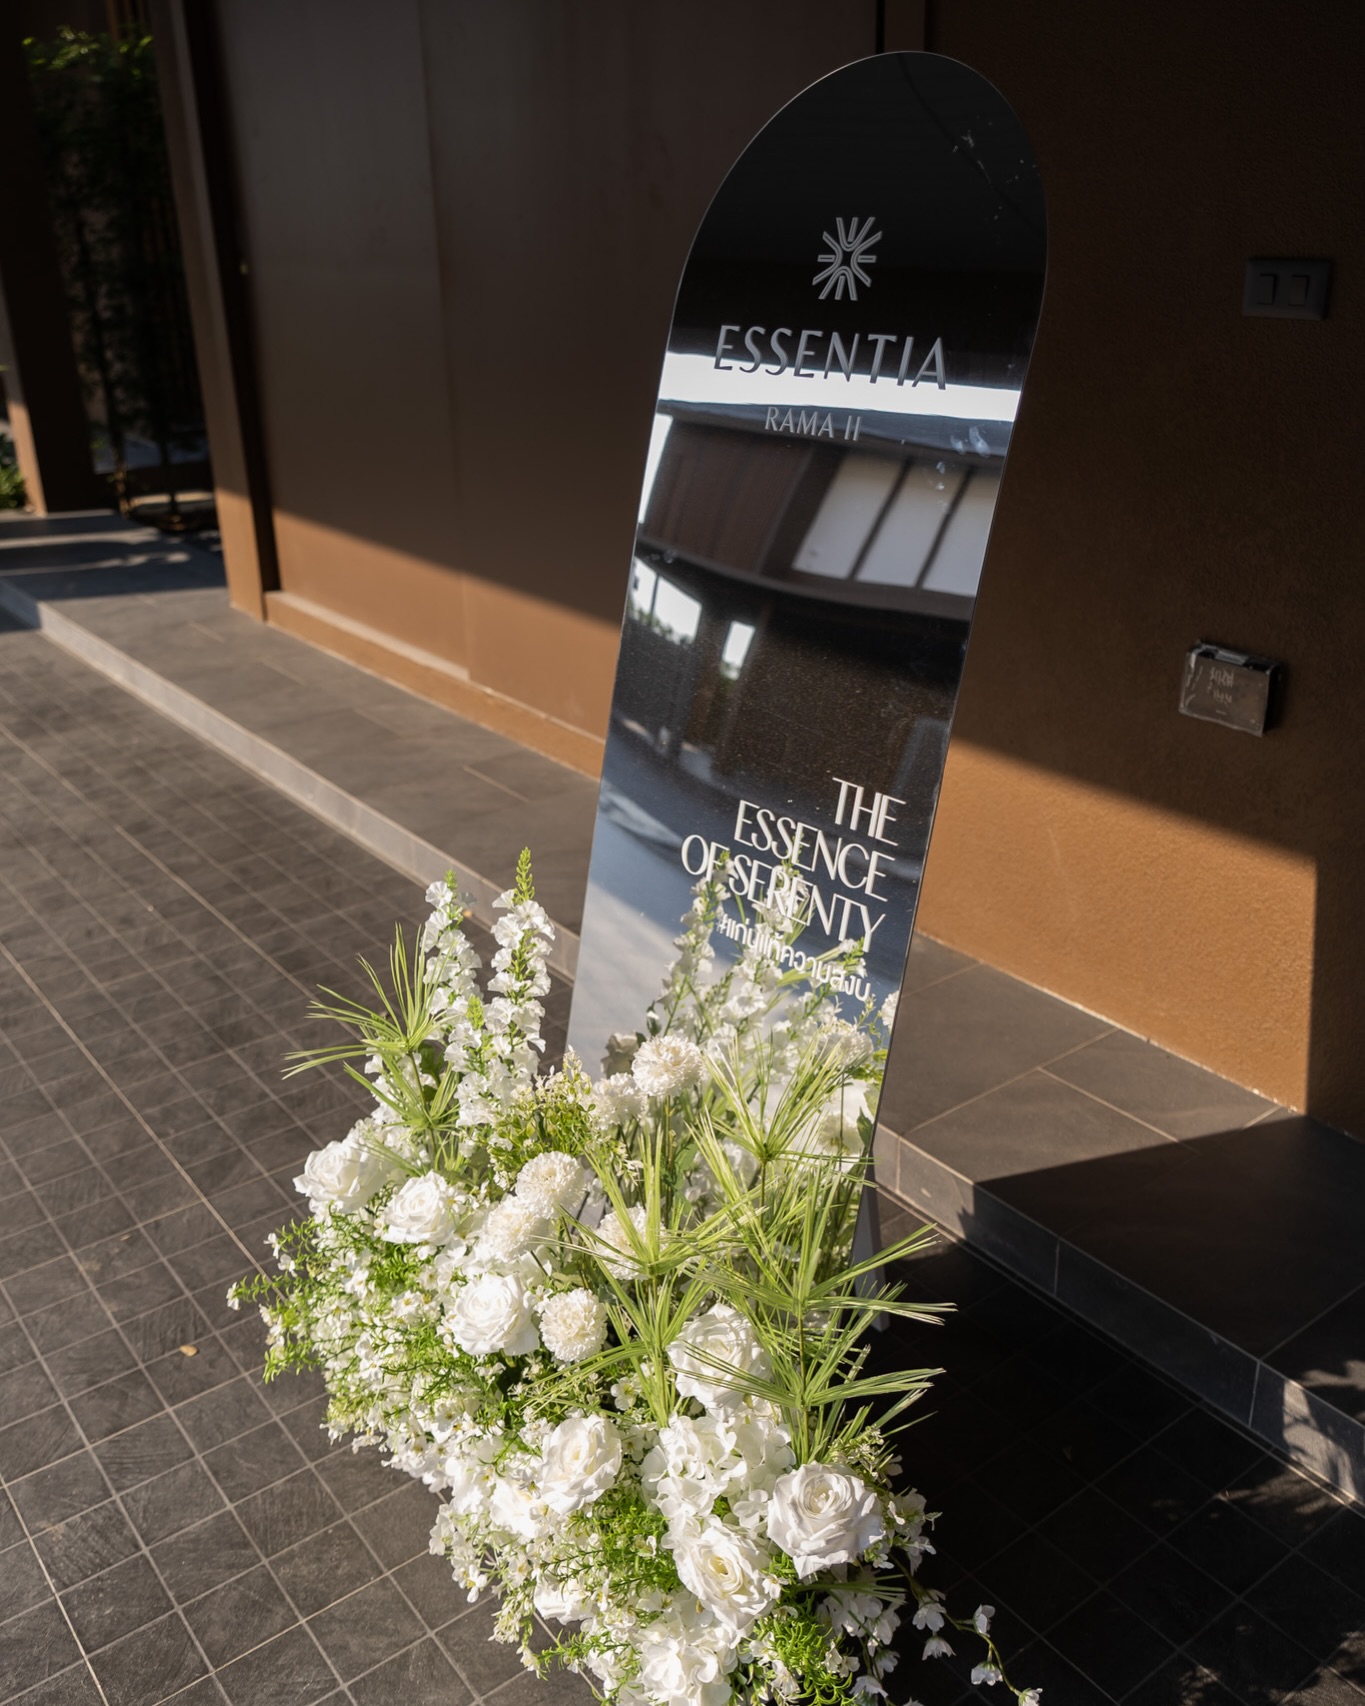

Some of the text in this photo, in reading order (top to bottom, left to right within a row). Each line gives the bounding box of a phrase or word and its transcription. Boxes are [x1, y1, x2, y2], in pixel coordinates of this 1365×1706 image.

[713, 324, 947, 391] ESSENTIA
[764, 405, 862, 442] RAMA II
[832, 776, 907, 847] THE
[681, 834, 731, 882] OF
[733, 799, 896, 902] ESSENCE
